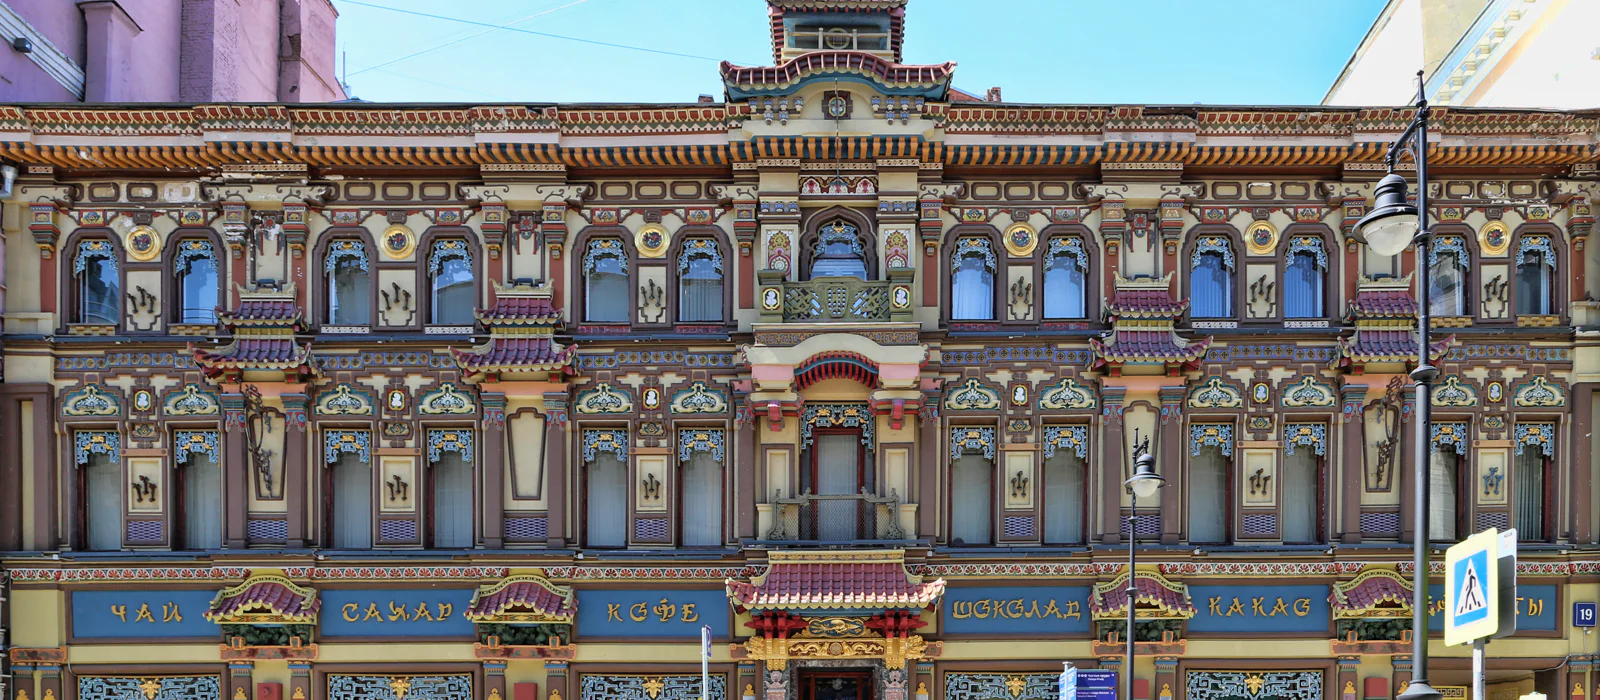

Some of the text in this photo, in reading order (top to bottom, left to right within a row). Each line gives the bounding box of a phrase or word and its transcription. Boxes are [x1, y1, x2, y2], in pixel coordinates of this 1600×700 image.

[111, 601, 183, 623] ЧАЙ
[341, 600, 453, 622] САХАР
[607, 598, 699, 622] КОФЕ
[952, 598, 1081, 621] ШОКОЛАД
[1208, 595, 1311, 617] КАКАО
[1579, 608, 1593, 620] 19
